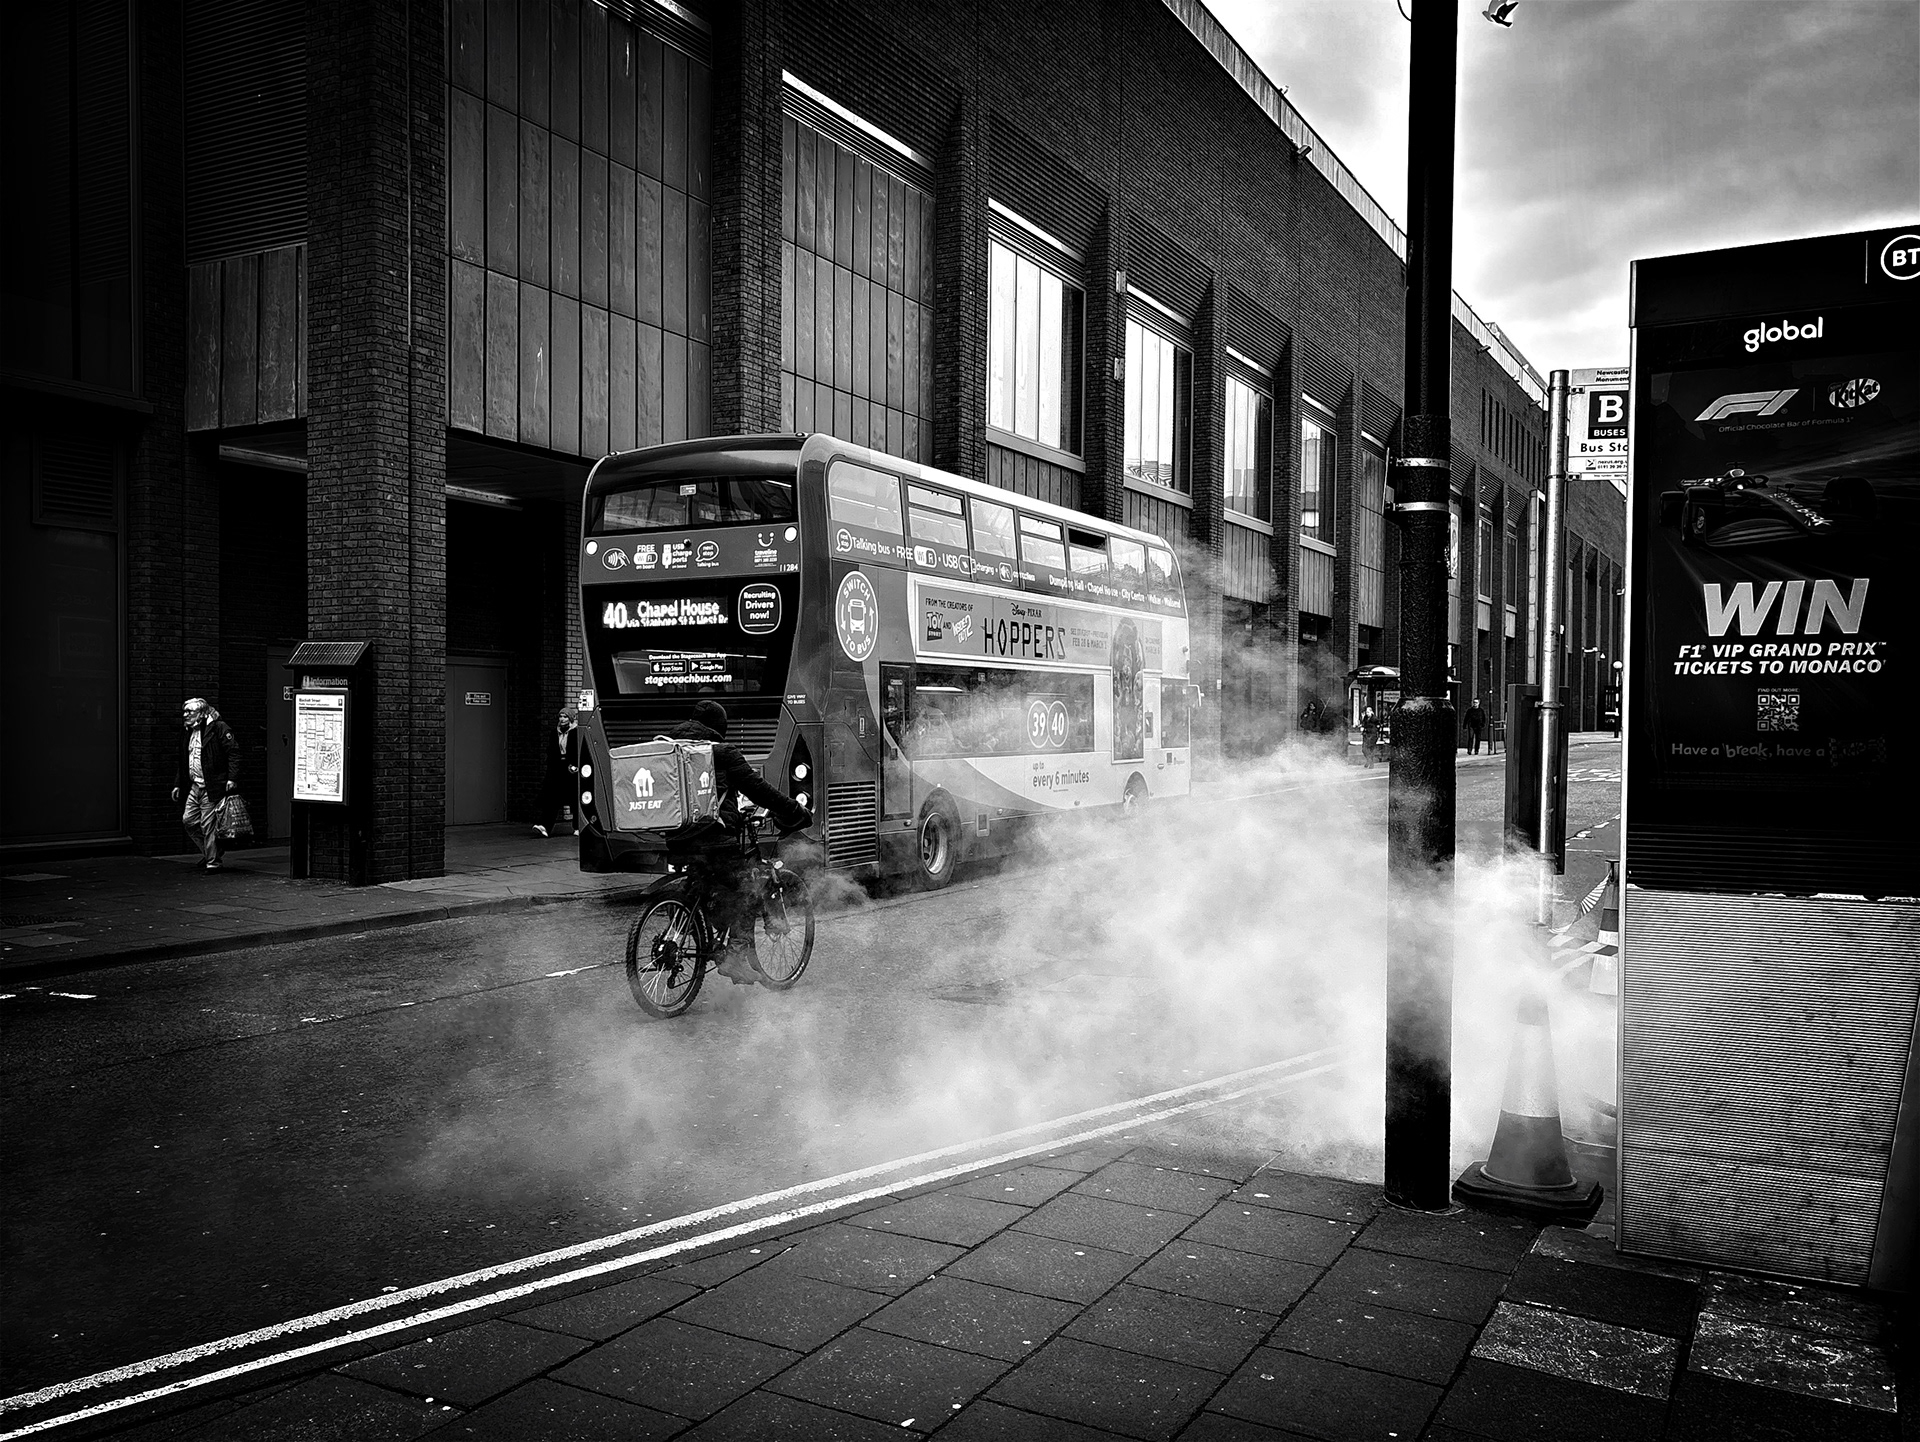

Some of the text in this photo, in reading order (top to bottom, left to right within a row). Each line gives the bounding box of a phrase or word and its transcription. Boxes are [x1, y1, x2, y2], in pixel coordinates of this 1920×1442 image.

[1892, 248, 1920, 267] BT
[1743, 316, 1823, 353] global
[1597, 395, 1623, 423] B
[1593, 429, 1626, 437] BUSES
[1718, 424, 1745, 433] Official
[1746, 421, 1785, 431] Chocolate
[1786, 420, 1800, 428] Bar
[1801, 419, 1811, 427] of
[1811, 417, 1844, 426] Formula
[1580, 443, 1604, 453] Bus
[636, 544, 655, 552] FREE
[851, 536, 877, 555] Talking
[878, 541, 891, 555] bus
[896, 545, 914, 560] FREE
[780, 564, 798, 572] 11284
[942, 553, 959, 569] USB
[744, 591, 776, 599] Recruiting
[843, 579, 870, 601] SWITCH
[637, 599, 719, 618] Chapel House
[745, 600, 774, 609] Drivers
[926, 598, 937, 606] FROM
[938, 599, 946, 608] THE
[947, 601, 967, 611] CREATORS
[1703, 578, 1870, 636] WIN
[604, 602, 627, 628] 40
[750, 610, 769, 619] now!
[926, 612, 943, 629] TOY
[943, 621, 951, 629] AND
[846, 634, 871, 654] TO BUS
[983, 617, 1066, 660] HOPPERS
[1712, 643, 1744, 658] VIP
[1749, 642, 1822, 657] GRAND
[1673, 661, 1753, 675] TICKETS
[1759, 660, 1784, 674] TO
[311, 677, 348, 686] Information
[645, 674, 732, 686] stagecoachbus.com
[1032, 712, 1046, 736] 39
[1052, 712, 1064, 735] 40
[1671, 743, 1708, 755] Have
[1711, 745, 1719, 755] a
[1776, 744, 1811, 757] have
[1816, 746, 1825, 756] a
[1033, 761, 1044, 771] up to
[1033, 770, 1089, 789] every 6 minutes
[628, 800, 663, 811] JUST EAT
